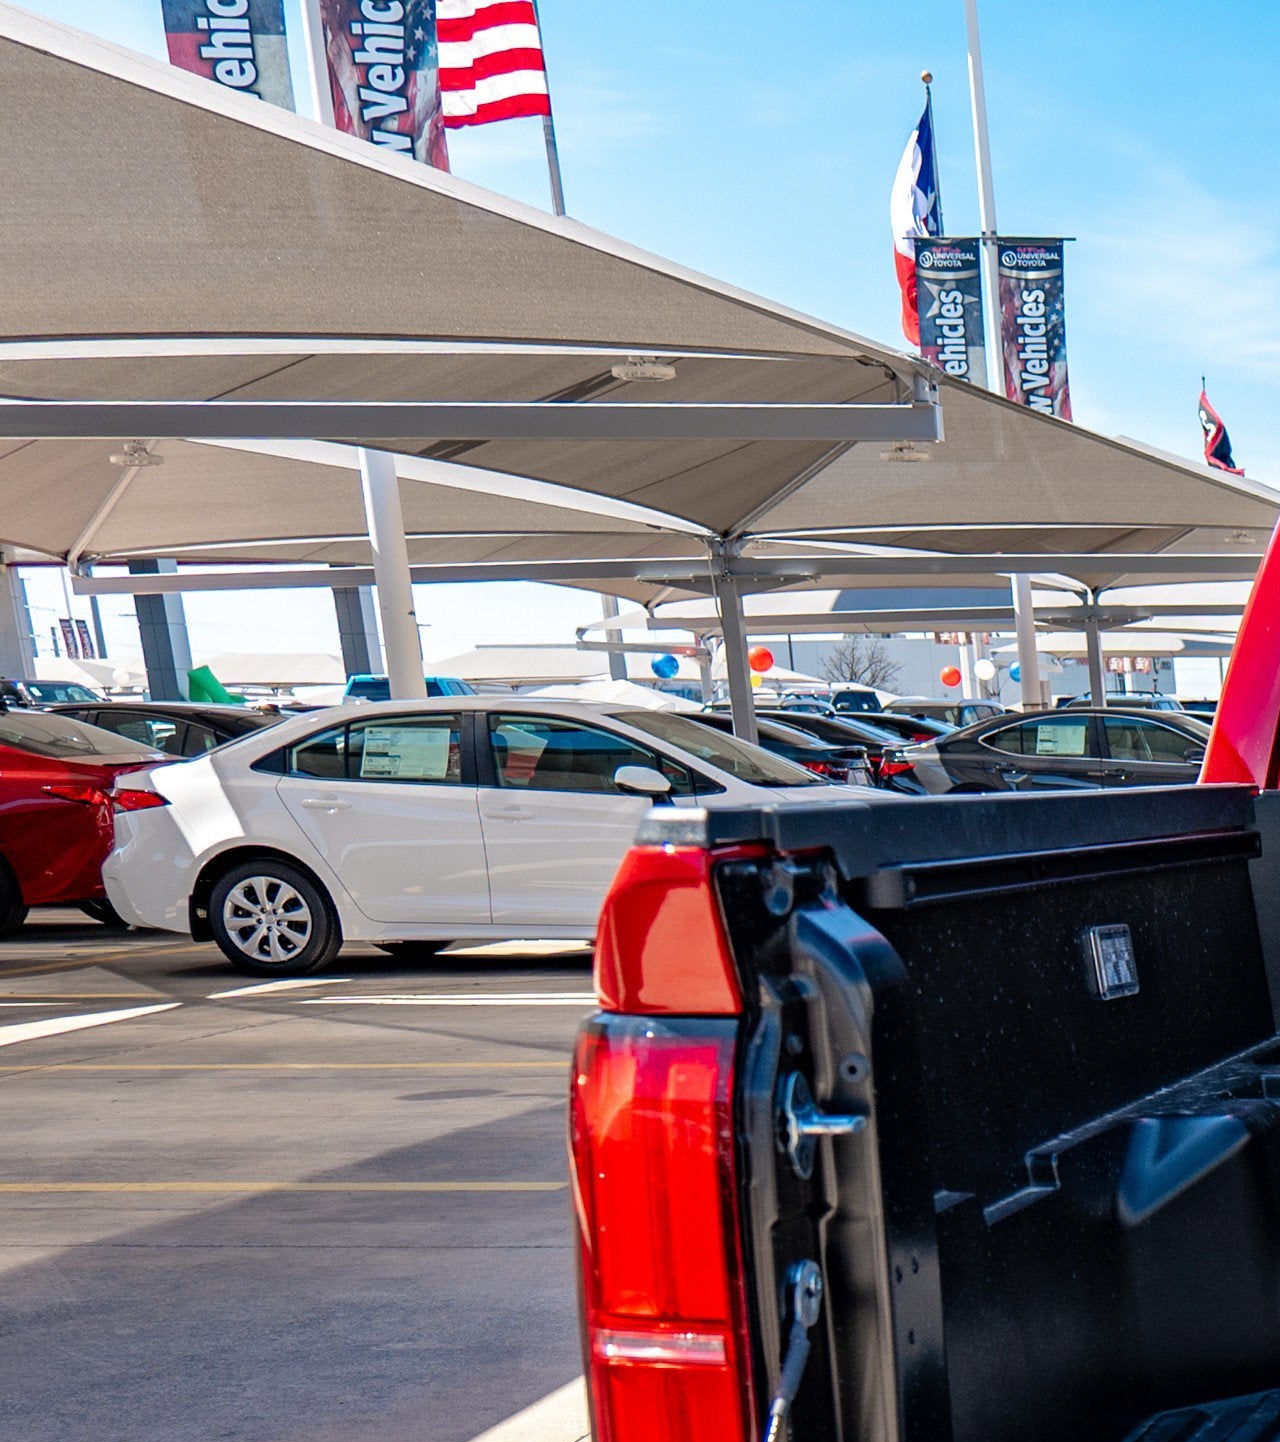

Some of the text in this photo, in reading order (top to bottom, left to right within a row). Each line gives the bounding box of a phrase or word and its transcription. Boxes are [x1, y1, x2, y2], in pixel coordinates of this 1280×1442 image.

[932, 252, 976, 260] UNIVERSAL
[1017, 252, 1060, 260] UNIVERSAL
[936, 291, 969, 382] ehicles
[1016, 289, 1050, 391] Vehicles
